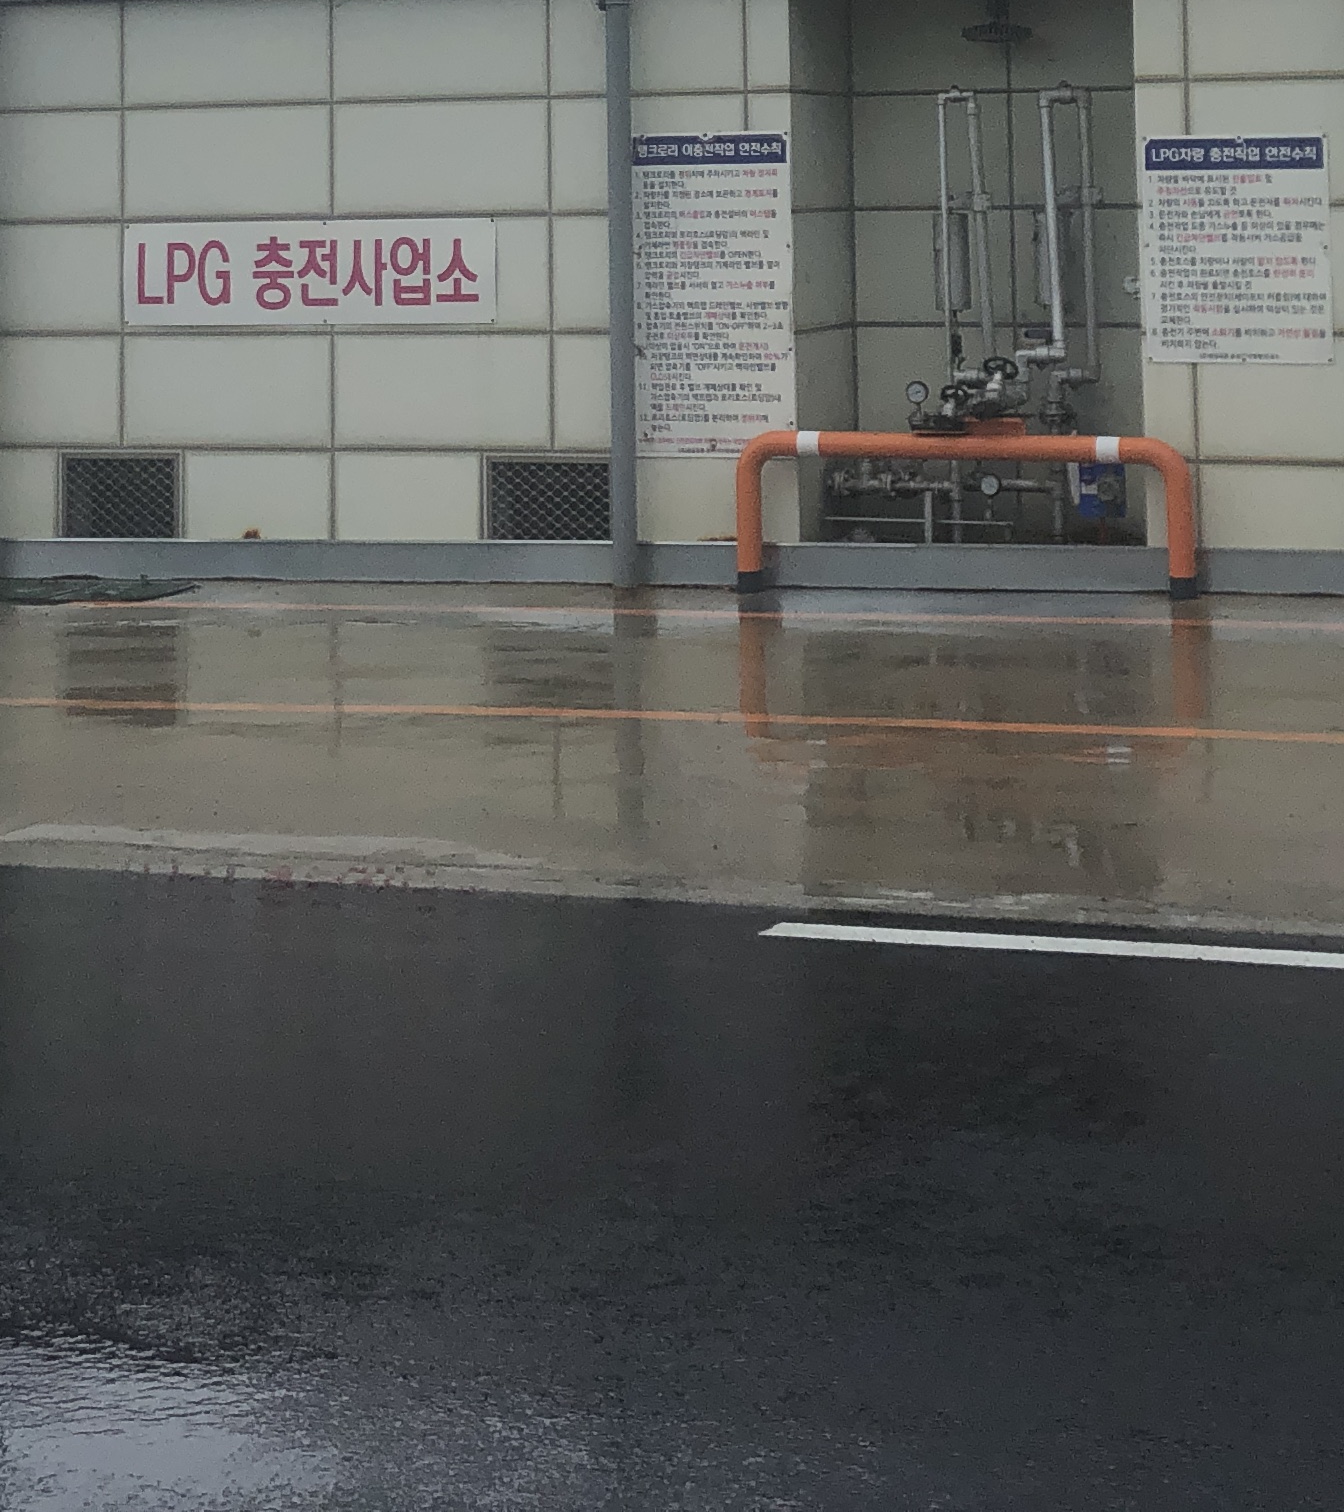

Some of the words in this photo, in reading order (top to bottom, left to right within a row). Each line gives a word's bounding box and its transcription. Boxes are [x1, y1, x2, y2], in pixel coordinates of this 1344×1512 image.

[682, 143, 735, 157] 이충전작업
[739, 141, 782, 155] 안전수칙
[1151, 147, 1205, 162] LPG차량
[1209, 147, 1260, 162] 충전작업
[1265, 146, 1317, 161] 안전수칙
[137, 240, 232, 306] LPG
[251, 236, 480, 311] 충전사업소
